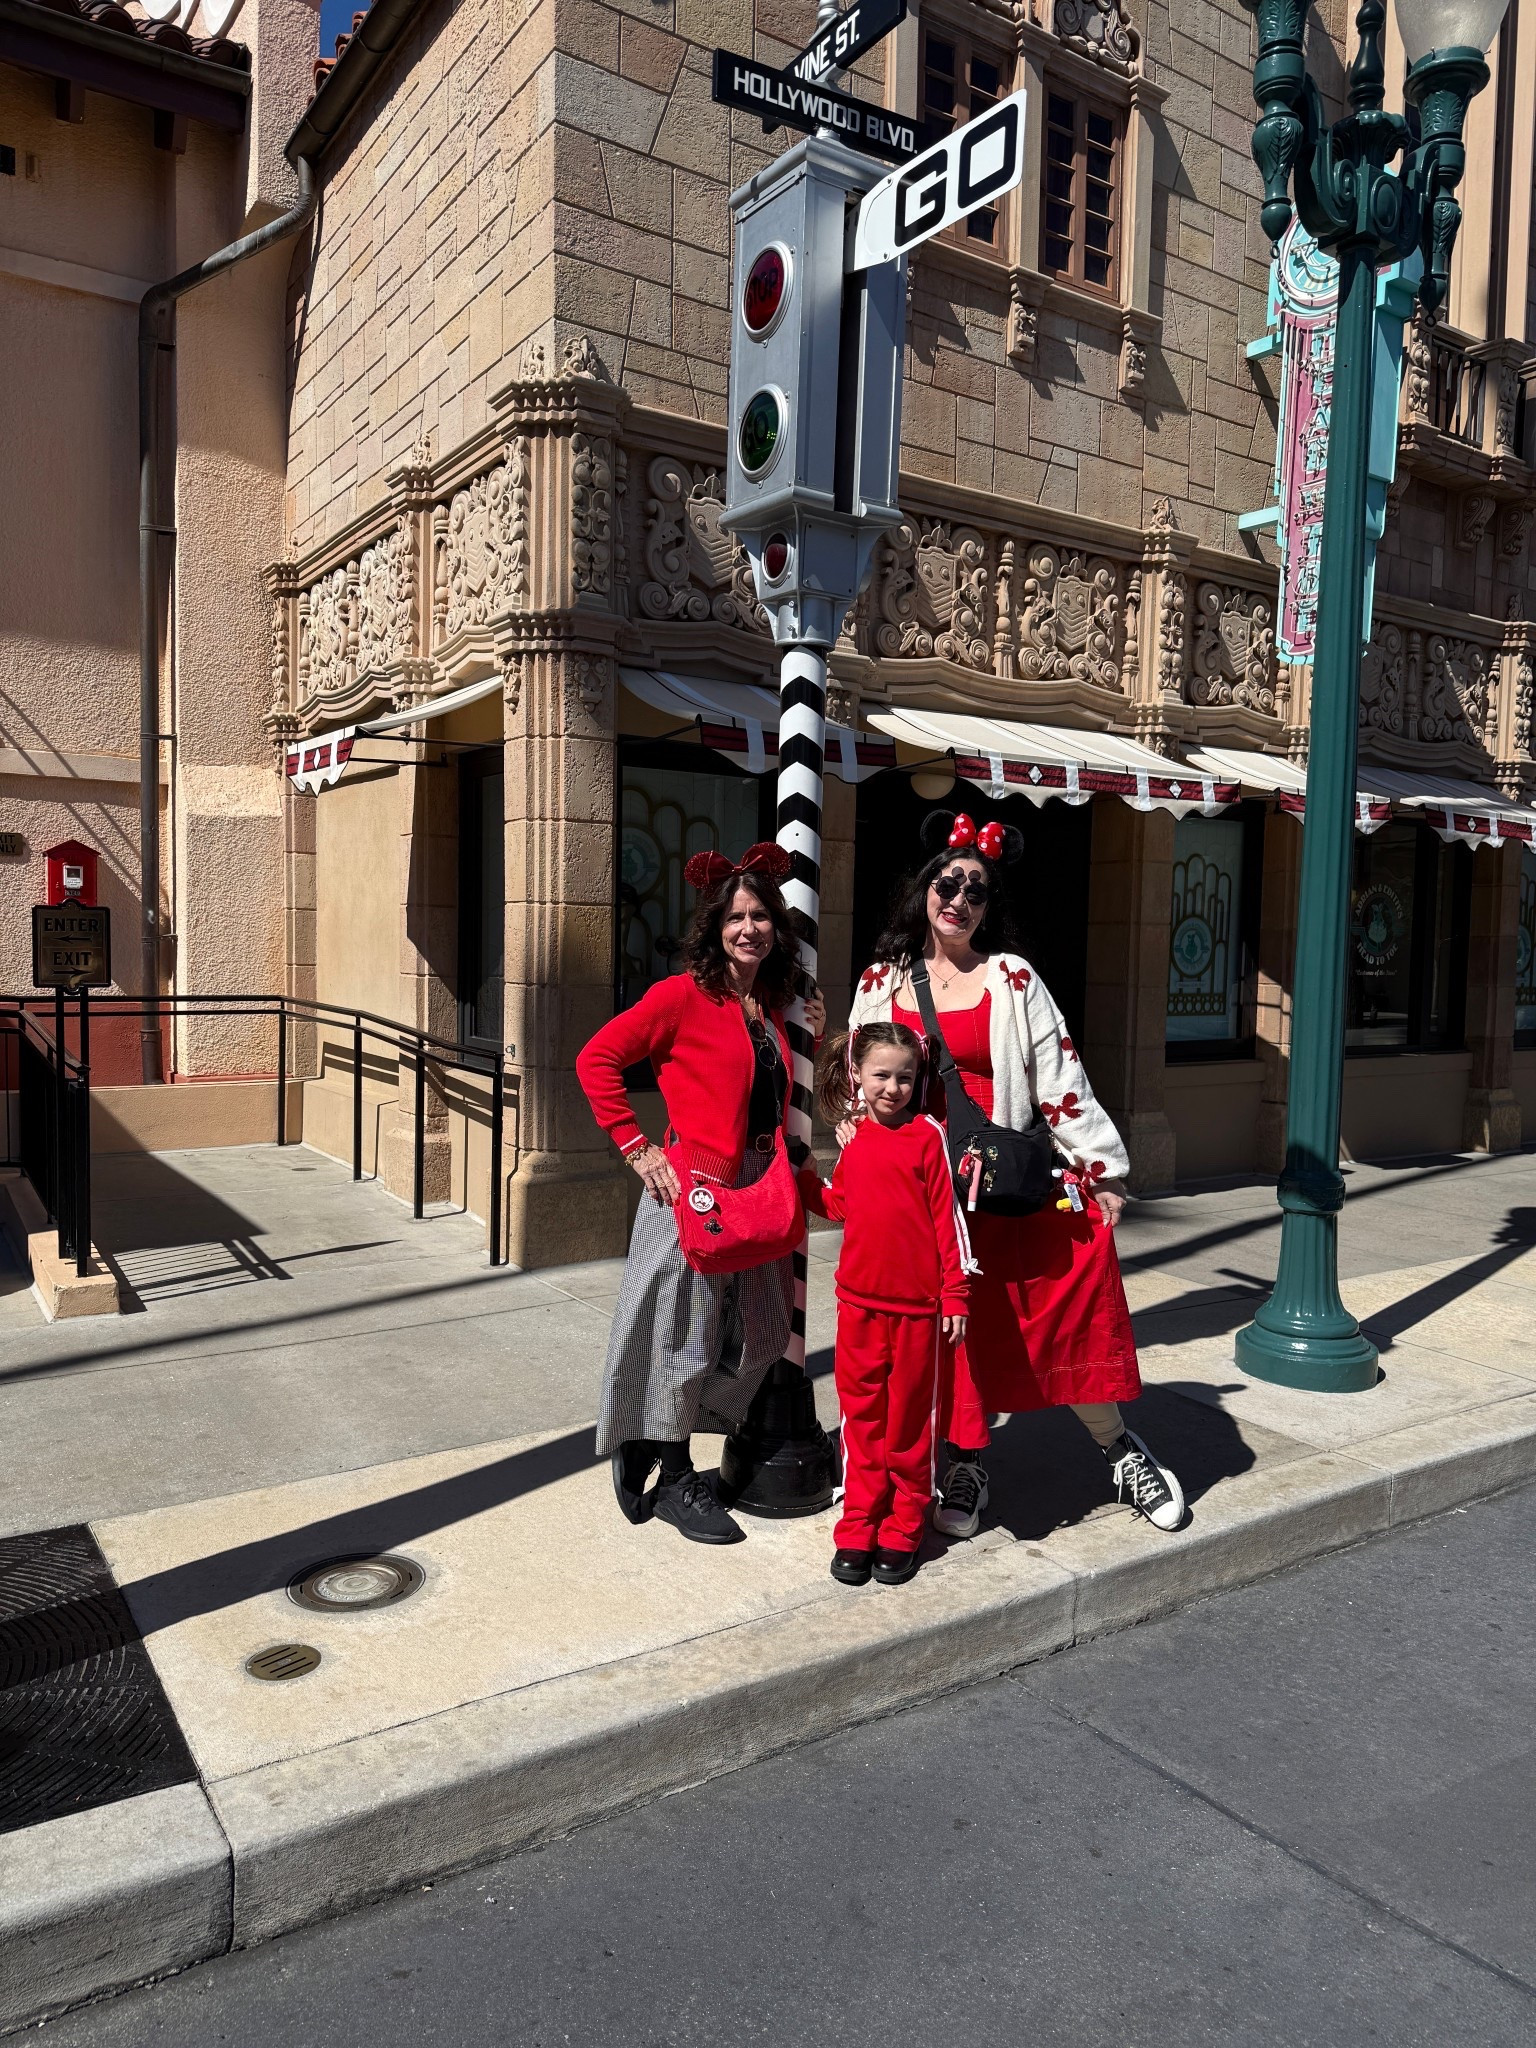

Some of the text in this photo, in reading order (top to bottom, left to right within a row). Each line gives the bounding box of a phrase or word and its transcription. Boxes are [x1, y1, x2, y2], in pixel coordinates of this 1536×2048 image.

[794, 8, 861, 82] VINE ST.
[733, 66, 918, 154] HOLLYWOOD BLVD.
[893, 103, 1019, 247] GO
[0, 834, 16, 844] XIT
[0, 843, 17, 853] NLY
[1354, 884, 1378, 917] ADRIAN
[44, 918, 99, 932] ENTER
[53, 951, 93, 966] EXIT
[1356, 940, 1399, 966] HEAD TO TOE
